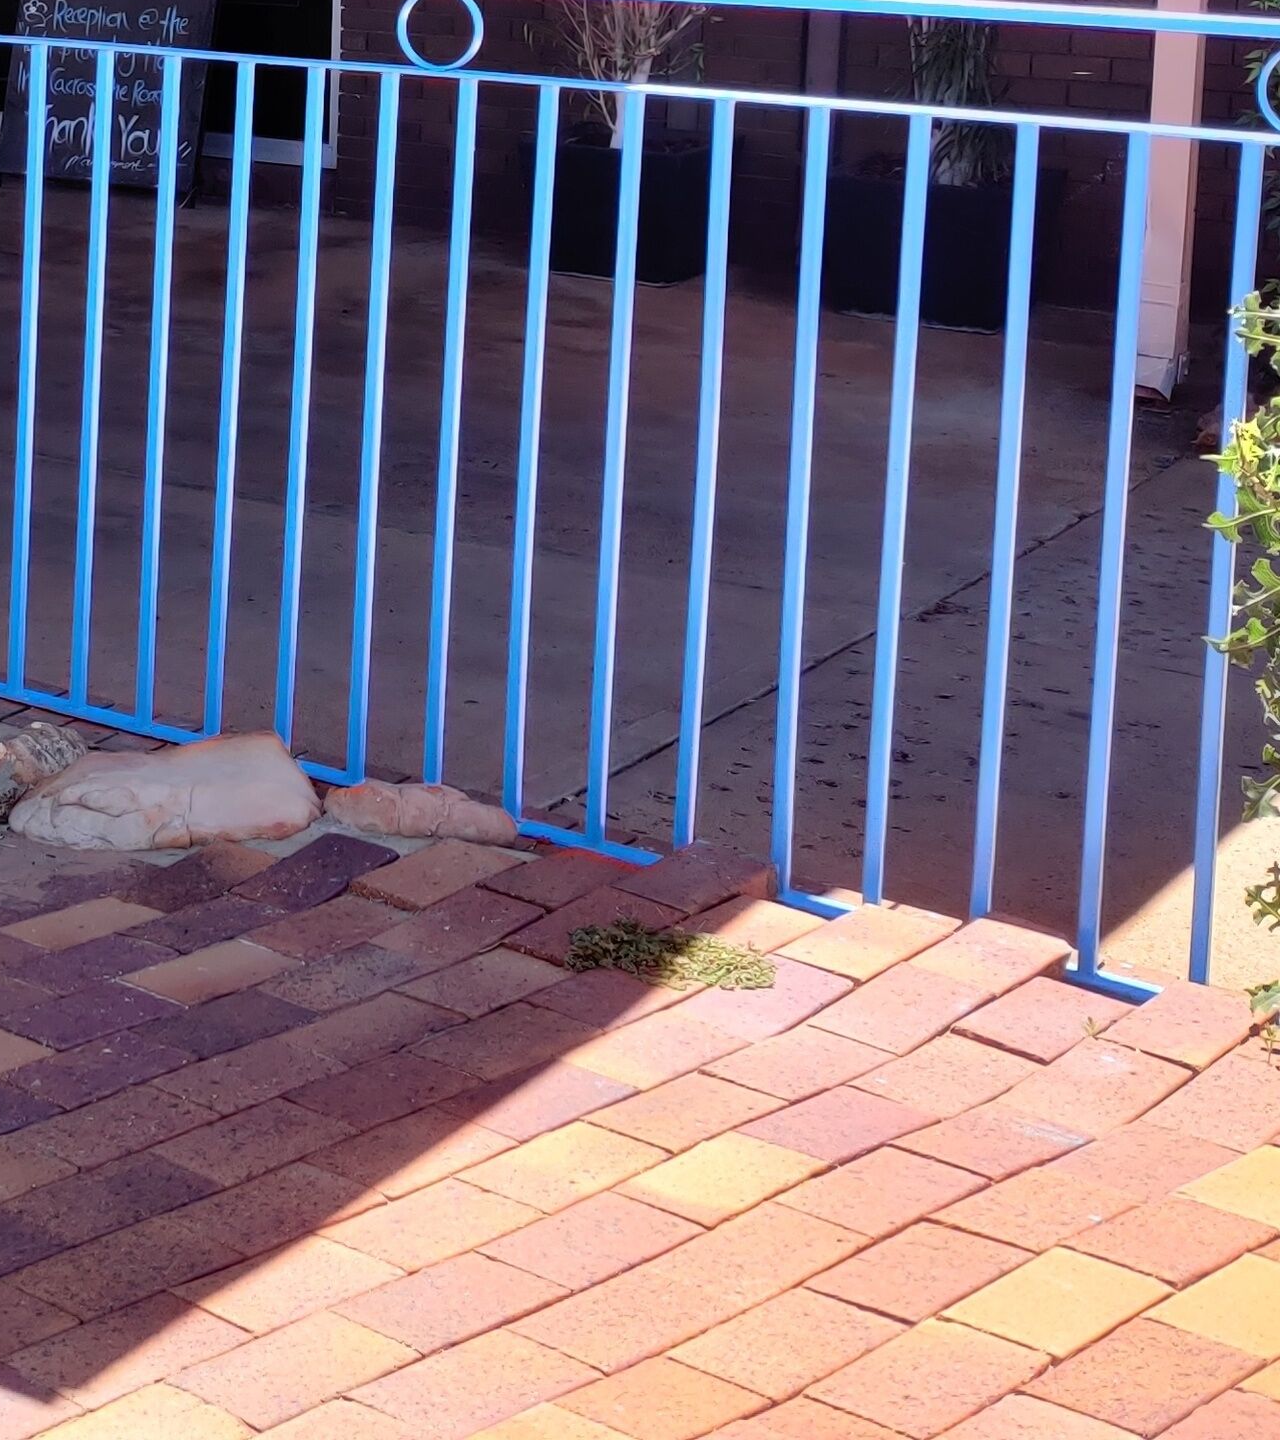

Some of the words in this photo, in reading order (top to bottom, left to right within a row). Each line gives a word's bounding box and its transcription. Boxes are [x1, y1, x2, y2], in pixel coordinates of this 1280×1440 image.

[140, 8, 159, 30] @
[159, 5, 191, 43] the
[118, 114, 162, 160] You
